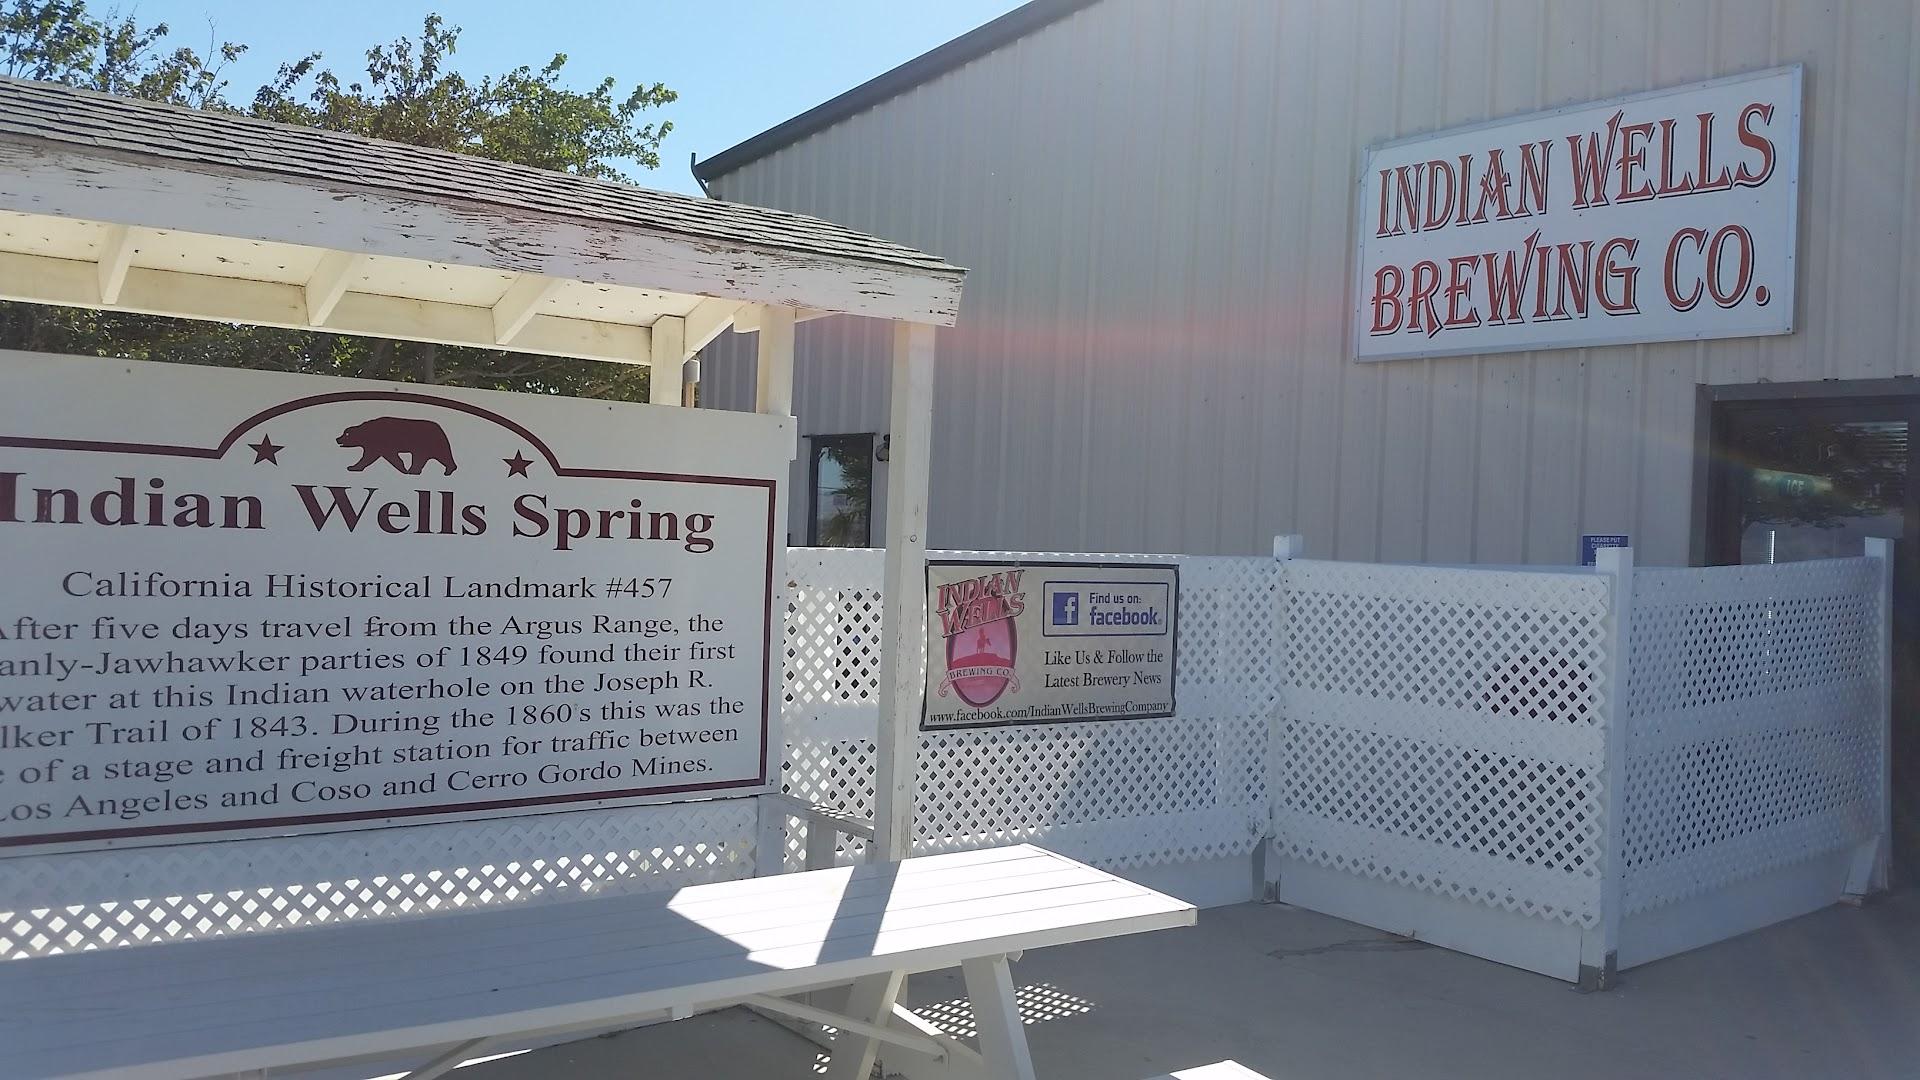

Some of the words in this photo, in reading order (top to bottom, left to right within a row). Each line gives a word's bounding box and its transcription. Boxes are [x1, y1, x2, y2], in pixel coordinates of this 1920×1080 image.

[1376, 139, 1553, 239] INDIAN
[1566, 102, 1777, 211] WELLS
[1369, 228, 1641, 338] BREWING
[1663, 224, 1771, 312] CO.
[0, 472, 266, 529] Indian
[291, 485, 486, 535] Wells
[513, 494, 714, 553] Spring
[63, 572, 252, 597] California
[266, 574, 430, 597] Historical
[445, 577, 596, 597] Landmark
[606, 578, 672, 598] #457
[936, 569, 1025, 613] INDIAN
[1089, 592, 1111, 605] Find
[1113, 595, 1124, 604] us
[1126, 595, 1142, 604] on:
[92, 617, 159, 639] five
[173, 617, 248, 644] days
[261, 617, 350, 637] travel
[365, 616, 436, 636] from
[449, 616, 491, 635] the
[500, 616, 582, 639] Argus
[593, 615, 678, 637] Range,
[689, 614, 723, 631] the
[938, 592, 1026, 638] WELLS
[0, 650, 290, 681] anly-Jawhawker
[301, 648, 404, 676] parties
[417, 647, 451, 667] of
[462, 646, 527, 666] 1849
[541, 644, 614, 663] found
[625, 643, 680, 661] their
[690, 642, 735, 659] first
[949, 667, 993, 679] BREWING
[1044, 651, 1072, 666] Like
[1075, 651, 1091, 665] Us
[1093, 652, 1104, 664] &
[1107, 651, 1145, 664] Follow
[1147, 650, 1164, 663] the
[0, 692, 97, 712] water
[110, 690, 138, 708] at
[153, 685, 213, 707] this
[227, 683, 328, 705] Indian
[342, 679, 489, 701] waterhole
[501, 682, 534, 695] on
[545, 674, 584, 693] the
[594, 671, 678, 694] Joseph
[690, 671, 712, 687] R.
[1045, 673, 1080, 688] Latest
[1083, 672, 1130, 688] Brewery
[1133, 671, 1162, 685] News
[2, 725, 74, 748] lker
[86, 720, 167, 744] Trail
[183, 718, 221, 740] of
[235, 716, 317, 738] 1843.
[333, 711, 440, 735] During
[452, 708, 493, 728] the
[509, 704, 590, 725] 1860's
[601, 701, 645, 720] this
[656, 703, 700, 717] was
[710, 697, 743, 714] the
[929, 700, 1169, 723] www.facebook.com/IndianWellsBrewingCompany
[20, 759, 64, 783] of
[72, 765, 89, 780] a
[105, 760, 192, 782] stage
[206, 750, 263, 773] and
[277, 745, 382, 772] freight
[394, 743, 489, 763] station
[503, 736, 542, 755] for
[552, 730, 629, 752] traffic
[640, 729, 737, 746] between
[0, 803, 51, 822] os
[64, 789, 207, 819] Angeles
[221, 783, 278, 807] and
[292, 782, 370, 802] Coso
[383, 775, 436, 796] and
[448, 771, 527, 790] Cerro
[539, 761, 621, 783] Gordo
[632, 757, 712, 776] Mines.
